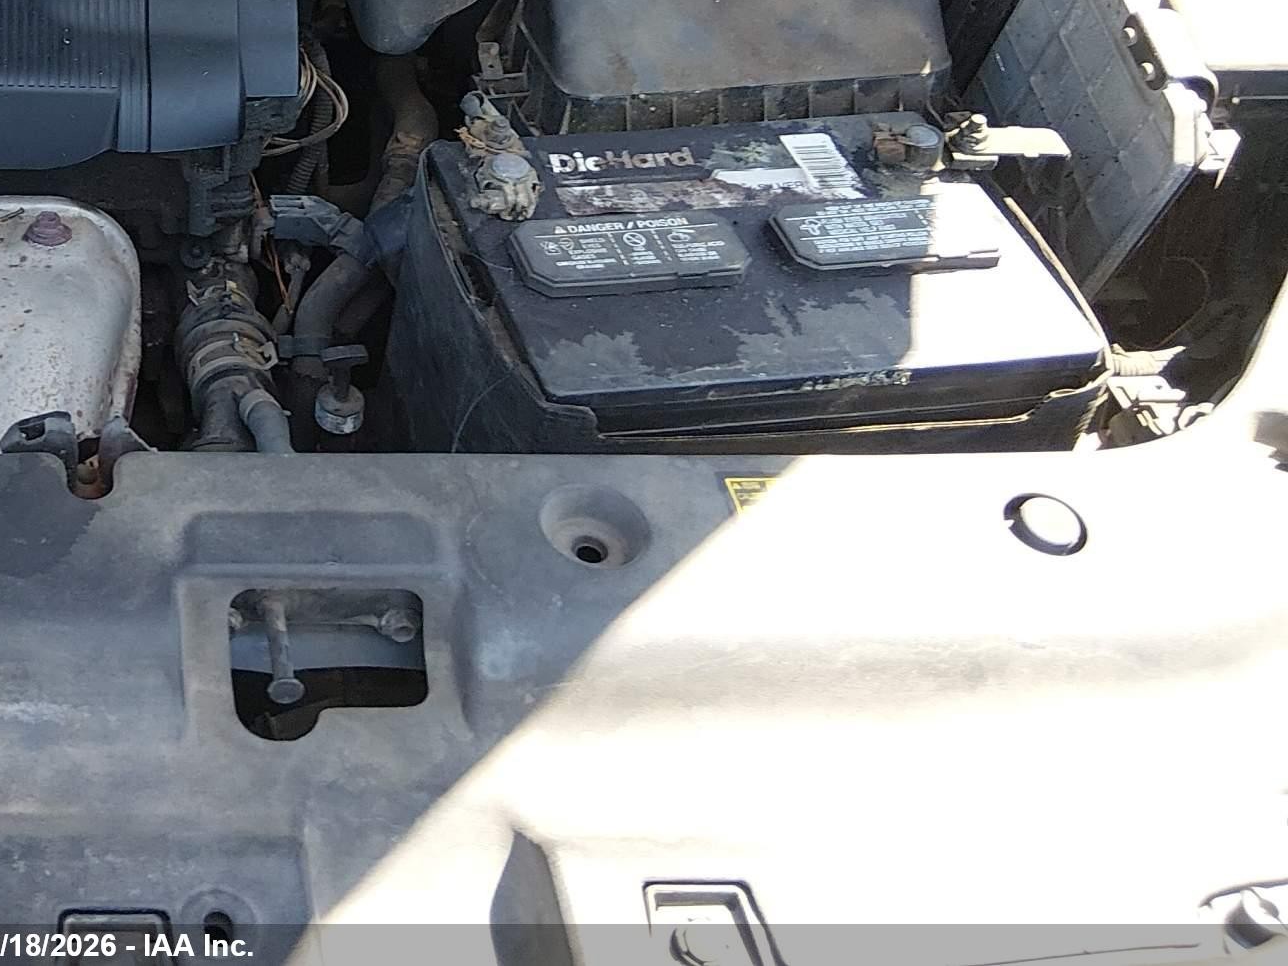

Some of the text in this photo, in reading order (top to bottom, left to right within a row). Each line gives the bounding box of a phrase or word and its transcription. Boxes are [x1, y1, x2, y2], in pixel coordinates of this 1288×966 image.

[548, 146, 696, 173] DieHard
[567, 222, 624, 235] DANGER
[638, 217, 689, 229] POISON
